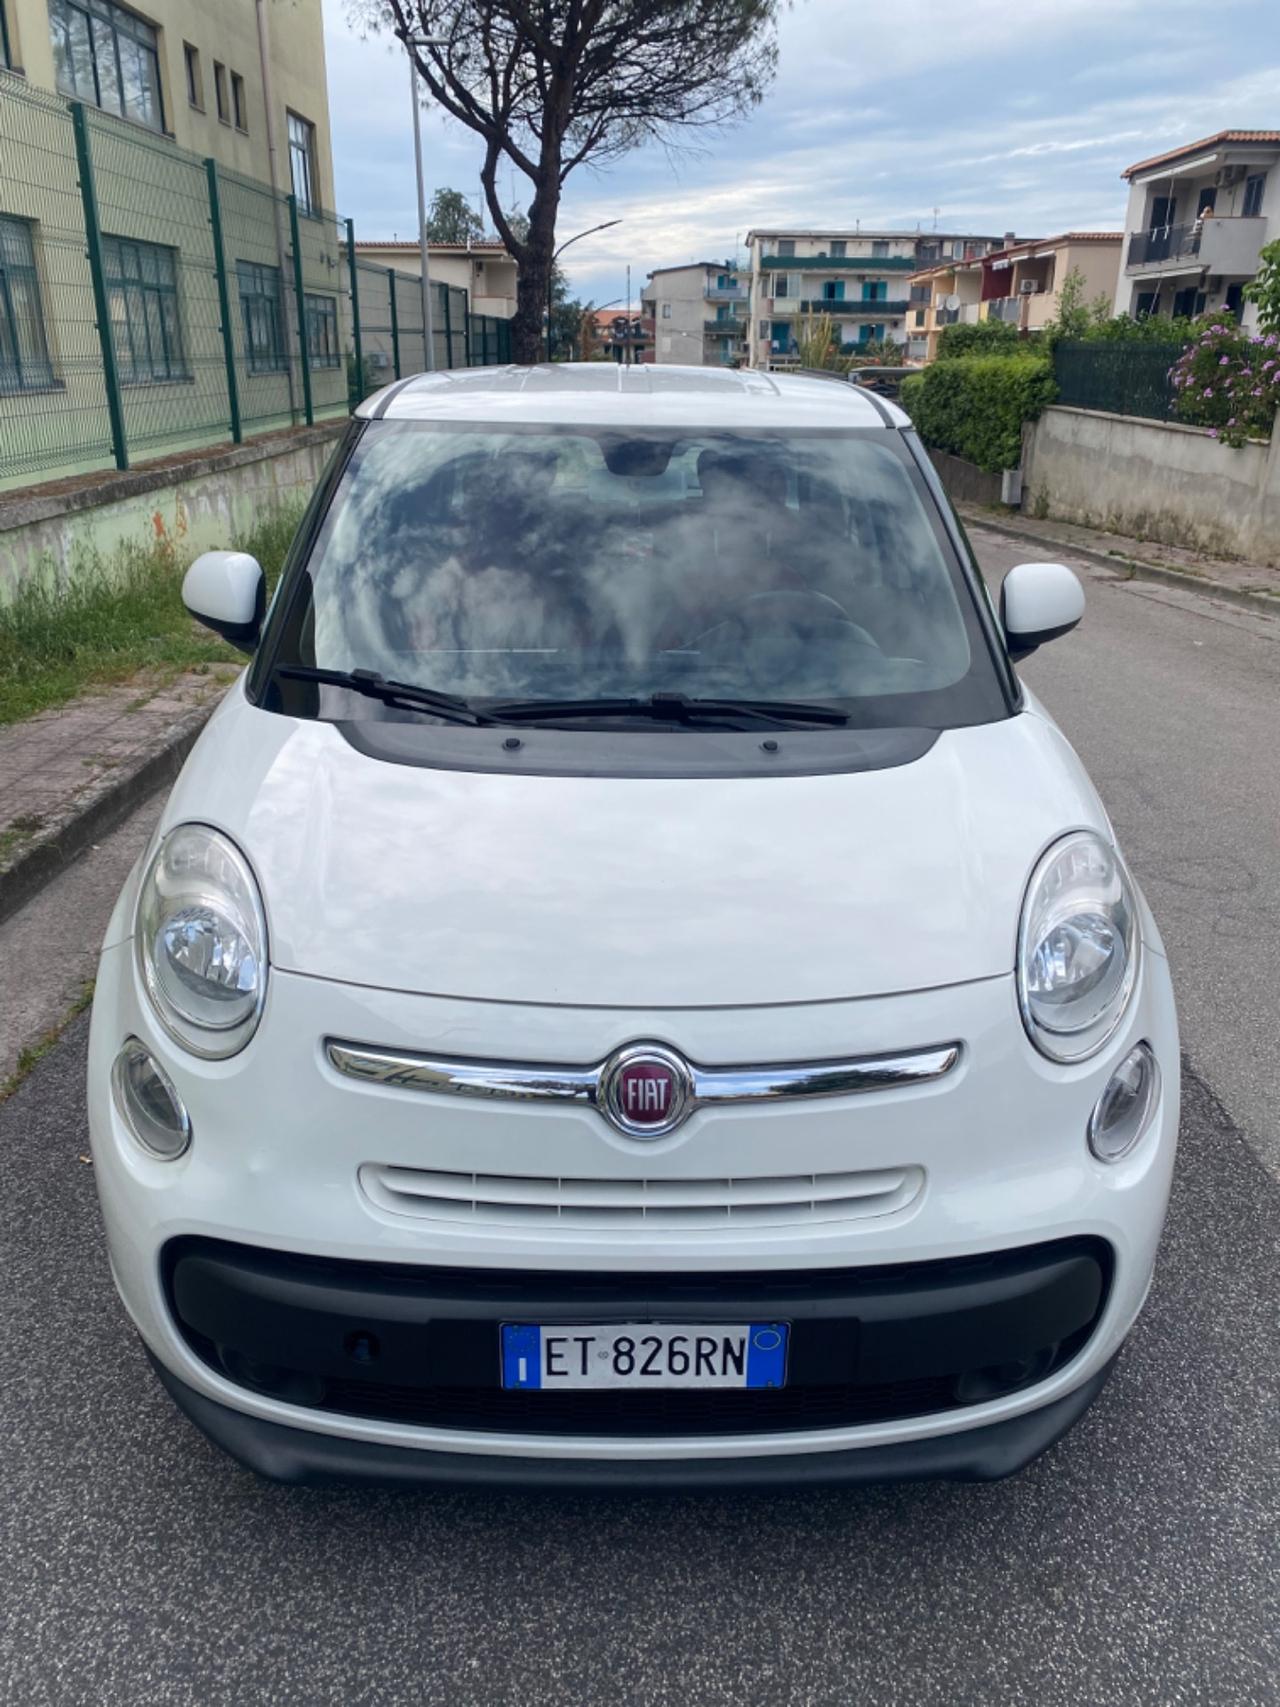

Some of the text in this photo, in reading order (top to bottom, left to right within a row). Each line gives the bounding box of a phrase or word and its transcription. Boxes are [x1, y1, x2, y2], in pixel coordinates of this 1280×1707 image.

[627, 1078, 669, 1111] FIAT
[545, 1336, 746, 1376] ET 826RN
